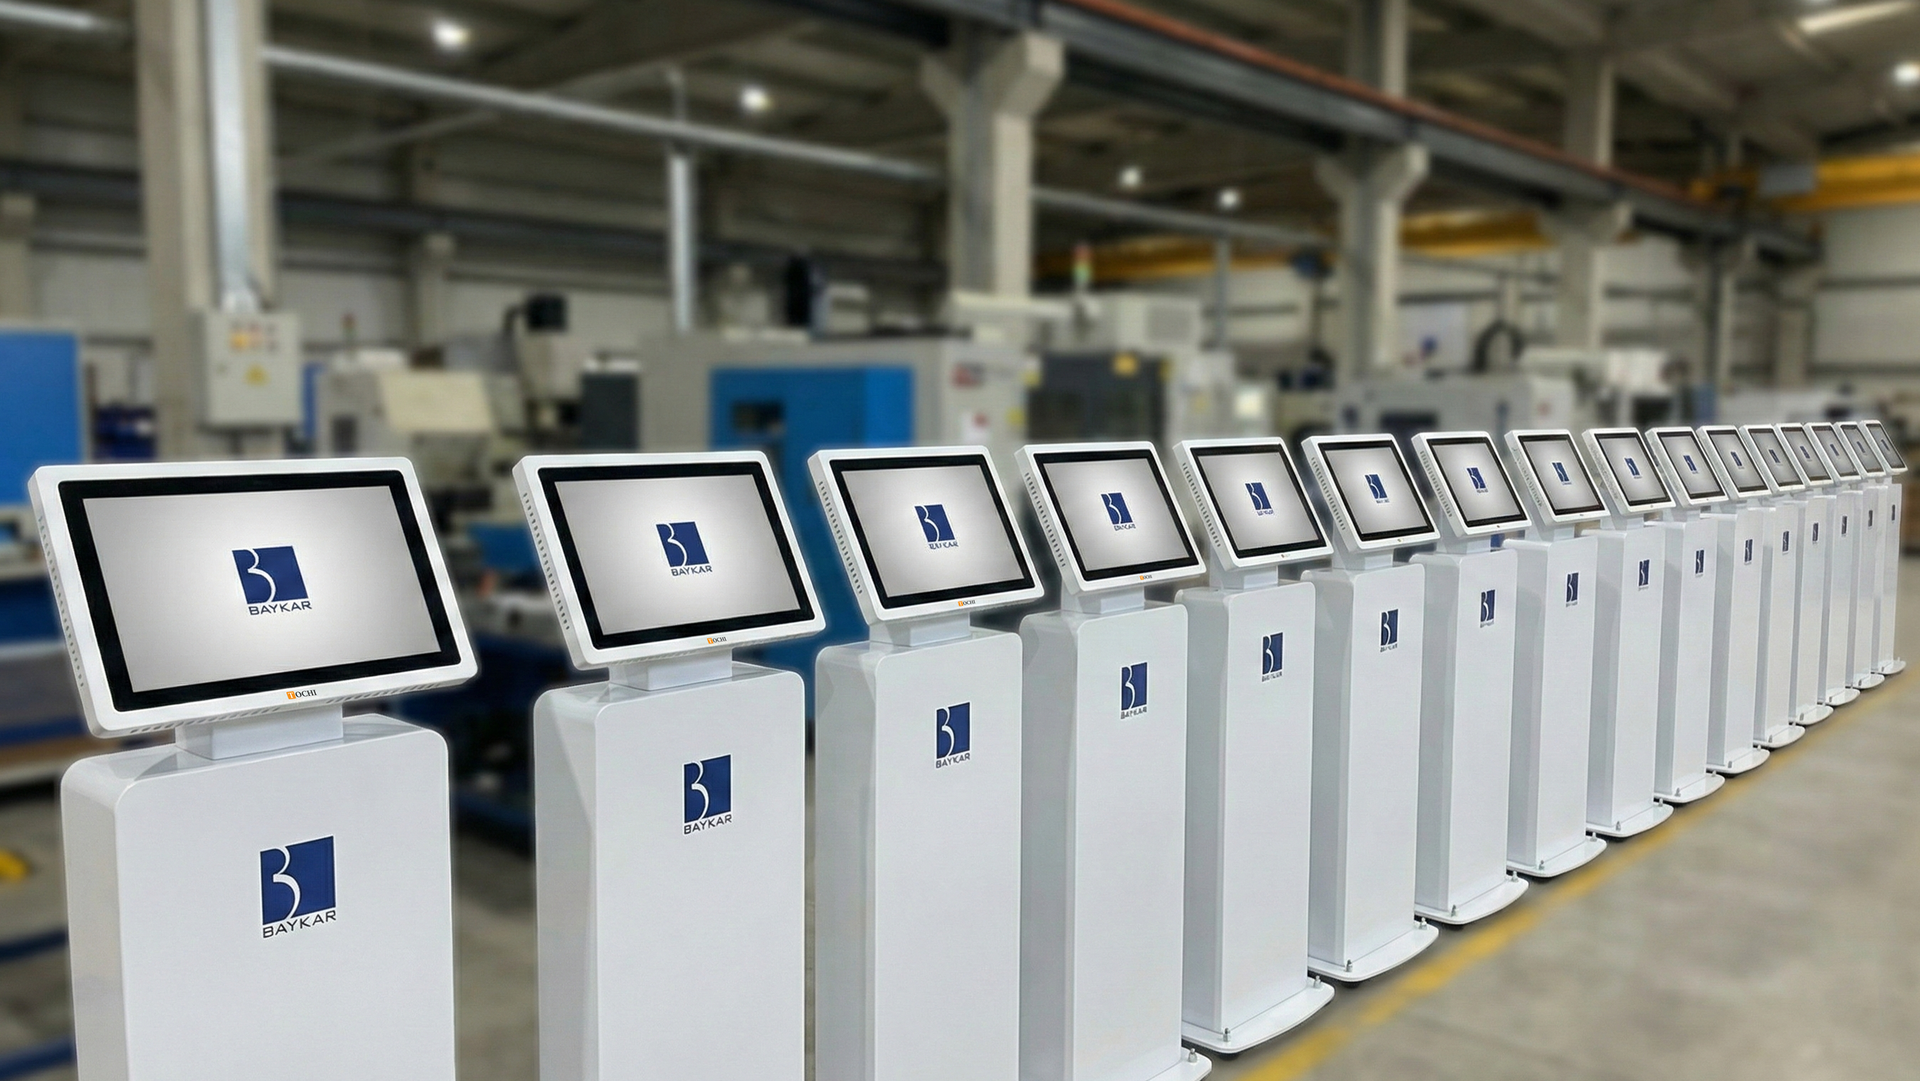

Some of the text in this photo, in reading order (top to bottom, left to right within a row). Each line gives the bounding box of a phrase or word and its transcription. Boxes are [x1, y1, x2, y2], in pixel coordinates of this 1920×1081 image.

[671, 565, 713, 577] BAYKAR
[249, 600, 312, 616] BAYKAR
[286, 689, 318, 700] TOCHI
[935, 752, 971, 769] BAYKAR
[683, 814, 732, 835] BAYKAR
[262, 909, 337, 939] BAYKAR
